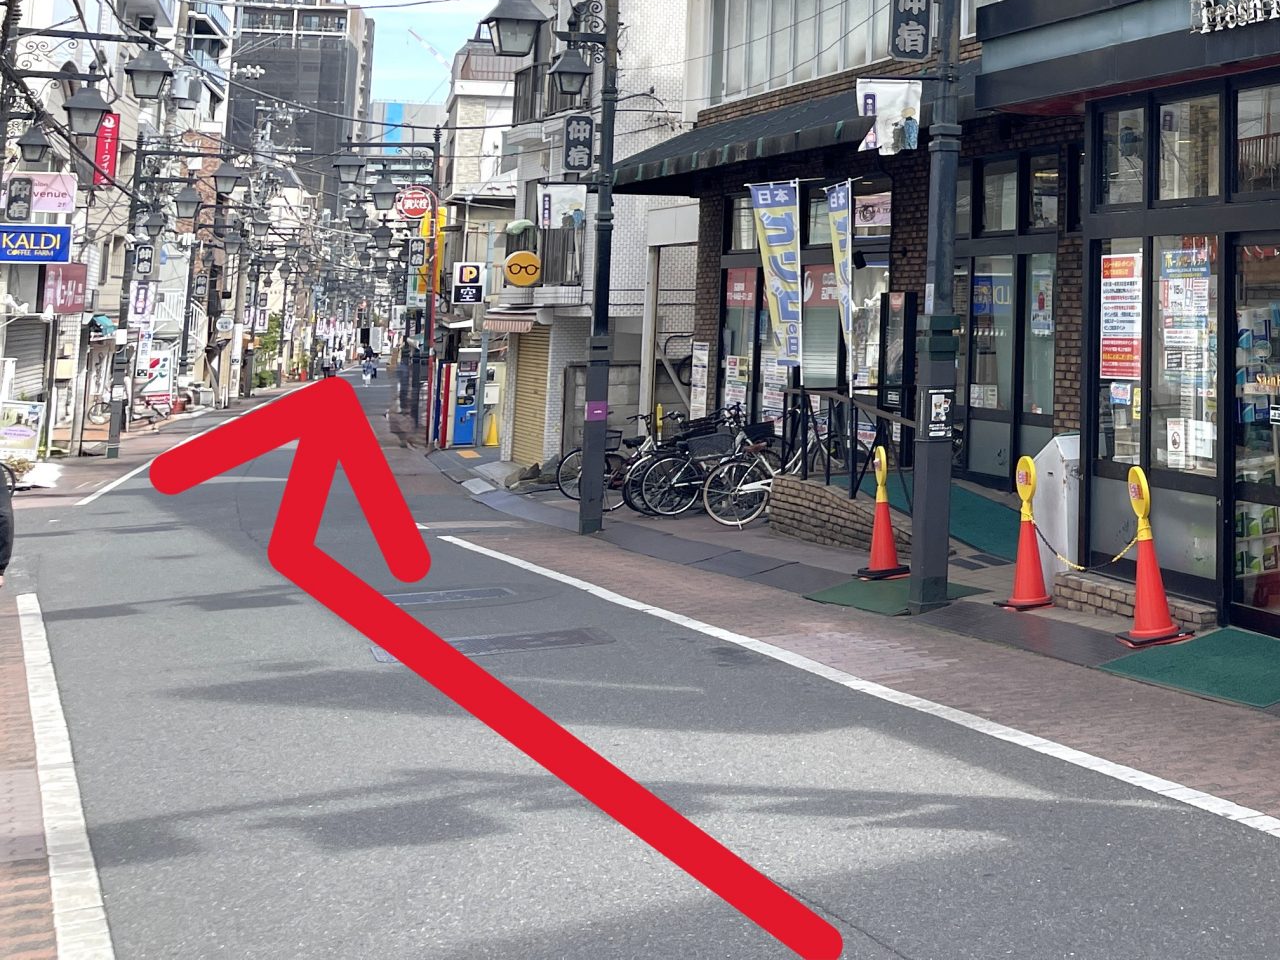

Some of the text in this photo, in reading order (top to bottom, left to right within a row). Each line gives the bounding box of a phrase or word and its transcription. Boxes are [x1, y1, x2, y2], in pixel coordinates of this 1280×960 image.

[567, 120, 591, 167] 仲宿
[9, 181, 31, 219] 仲宿
[2, 234, 61, 250] KALDI
[7, 249, 31, 257] COFFEE
[463, 266, 478, 283] P
[460, 287, 476, 302] 空
